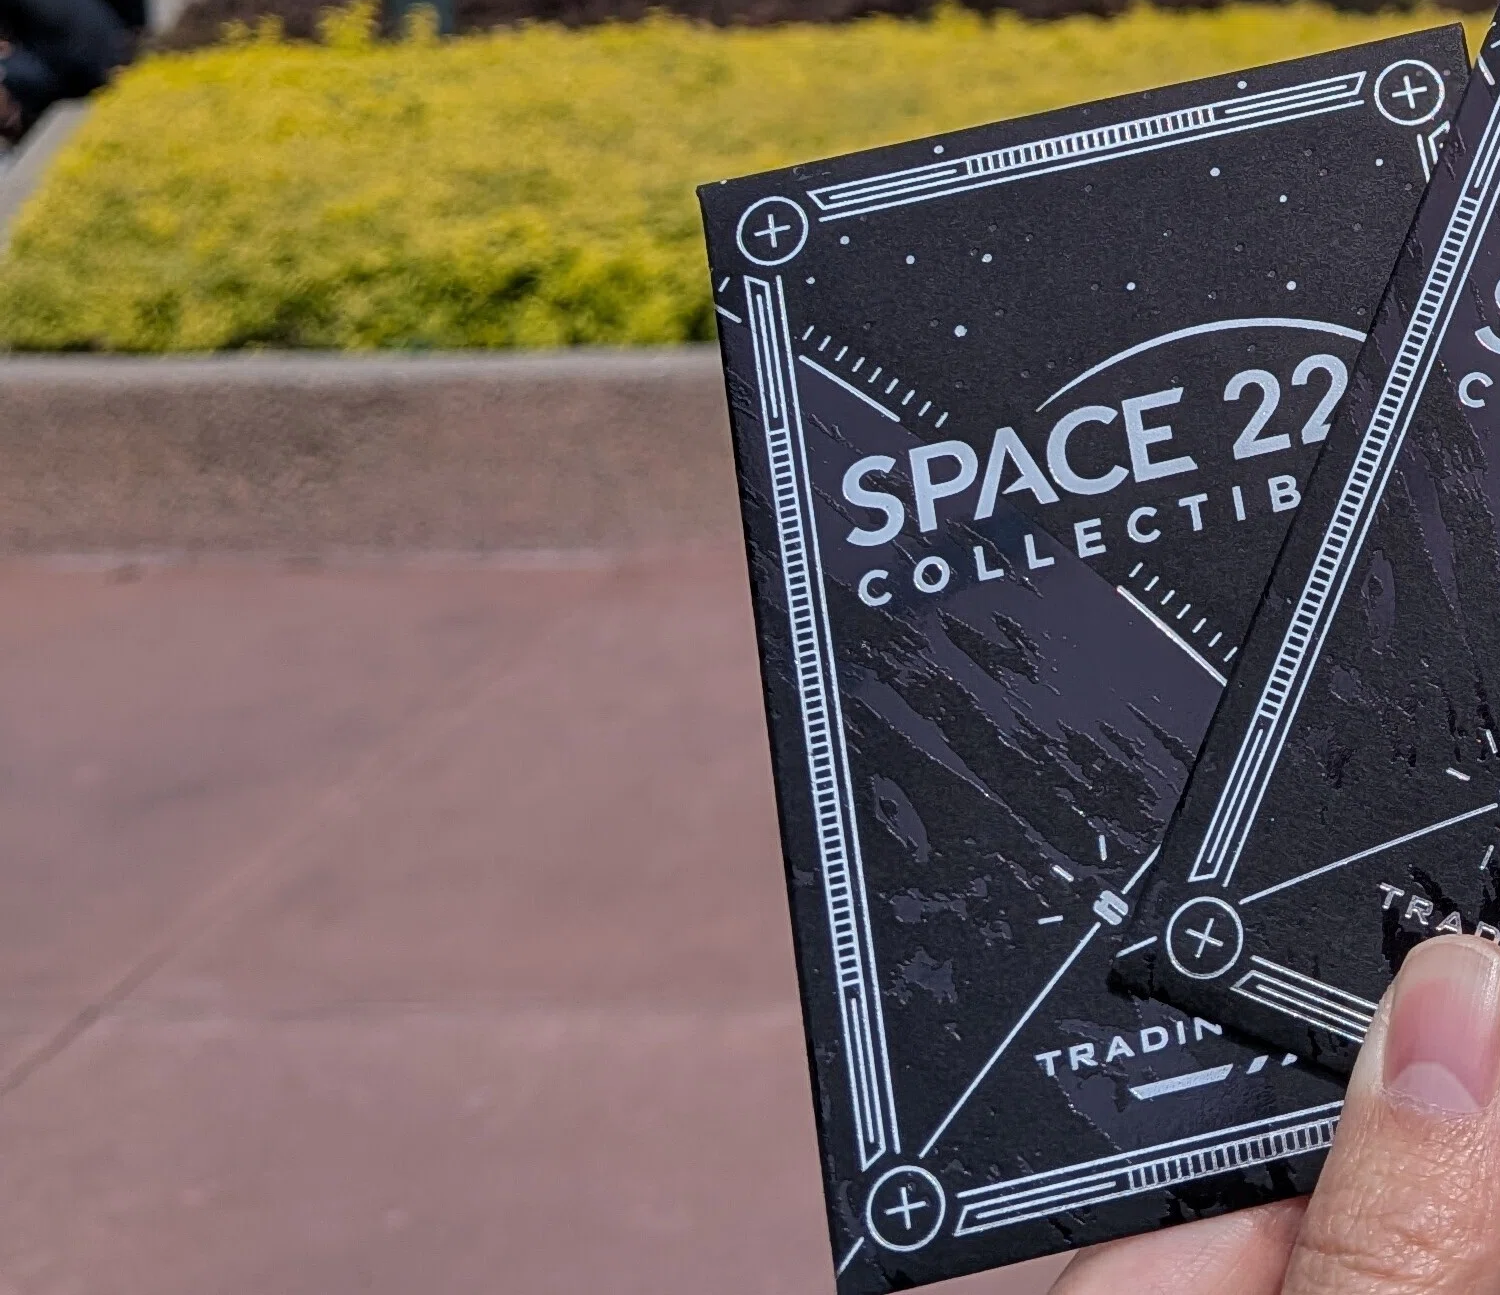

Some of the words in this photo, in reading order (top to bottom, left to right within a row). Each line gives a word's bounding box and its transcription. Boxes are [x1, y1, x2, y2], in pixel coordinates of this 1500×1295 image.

[842, 387, 1199, 547] SPACE
[1223, 353, 1349, 461] 22
[858, 474, 1302, 607] COLLECTIB
[1034, 1016, 1223, 1077] TRADIN
